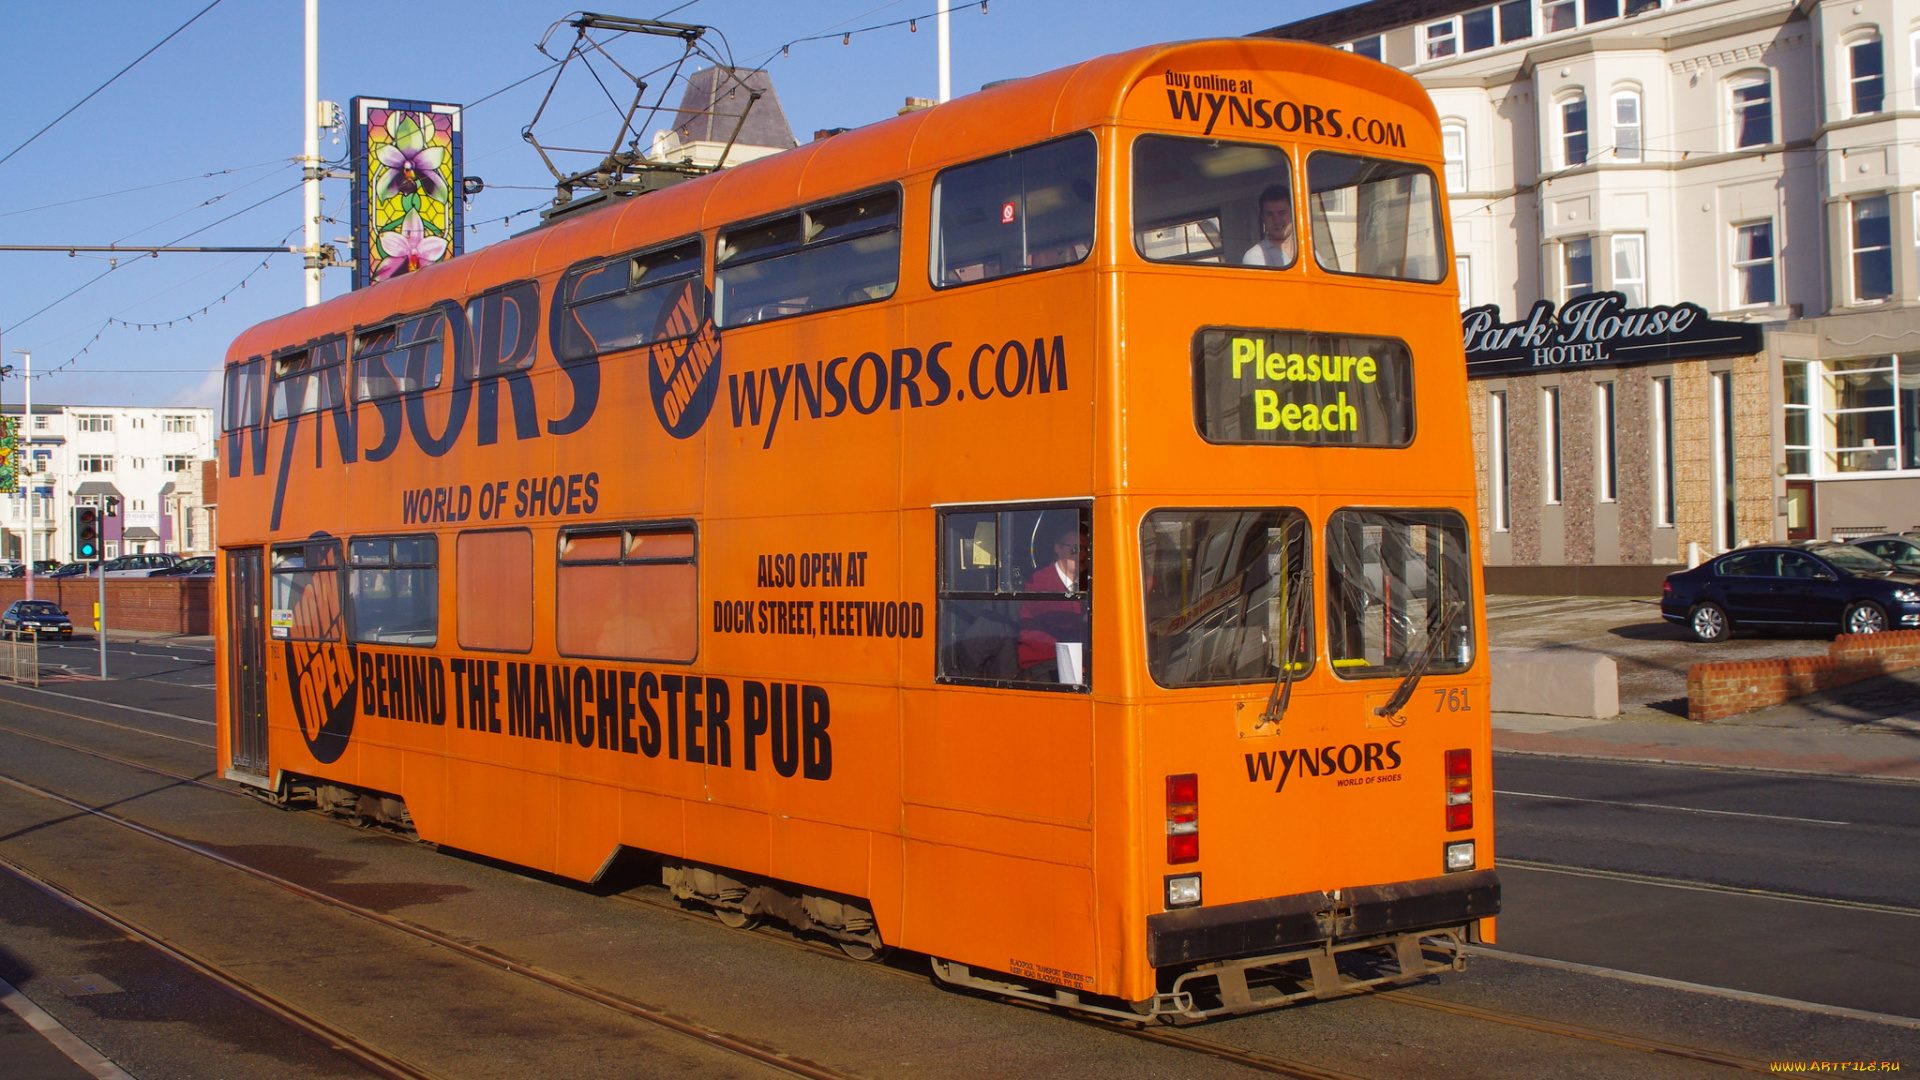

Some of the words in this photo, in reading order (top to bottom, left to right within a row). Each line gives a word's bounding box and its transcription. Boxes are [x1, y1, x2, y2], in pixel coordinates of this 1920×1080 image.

[1165, 69, 1190, 89] buy
[1194, 74, 1237, 93] online
[1240, 78, 1253, 95] at
[652, 281, 700, 384] BUY
[1463, 304, 1553, 353] Park
[1558, 294, 1698, 345] House
[663, 318, 721, 428] ONLINE
[1232, 338, 1377, 383] Pleasure
[1532, 341, 1610, 367] HOTEL
[226, 258, 605, 531] WYNSORS
[729, 335, 1068, 449] WYNSORS.COM
[1254, 389, 1358, 432] Beach
[403, 485, 471, 524] WORLD
[479, 482, 508, 521] OF
[515, 472, 600, 518] SHOES
[757, 553, 796, 588] ALSO
[800, 553, 843, 588] OPEN
[846, 551, 868, 587] AT
[289, 547, 342, 677] NOW
[713, 602, 755, 635] DOCK
[759, 602, 817, 639] STREET,
[820, 601, 923, 639] FLEETWOOD
[299, 617, 356, 742] OPEN
[1434, 688, 1471, 713] 761
[361, 652, 446, 726] BEHIND
[451, 657, 502, 734] THE
[507, 663, 732, 767] MANCHESTER
[744, 681, 833, 781] PUB
[1245, 740, 1402, 793] WYNSORS
[1337, 776, 1363, 788] WORLD
[1365, 775, 1375, 786] OF
[1377, 773, 1402, 785] SHOES
[1036, 964, 1061, 977] TRANSPORT
[1062, 970, 1084, 982] SERVICES
